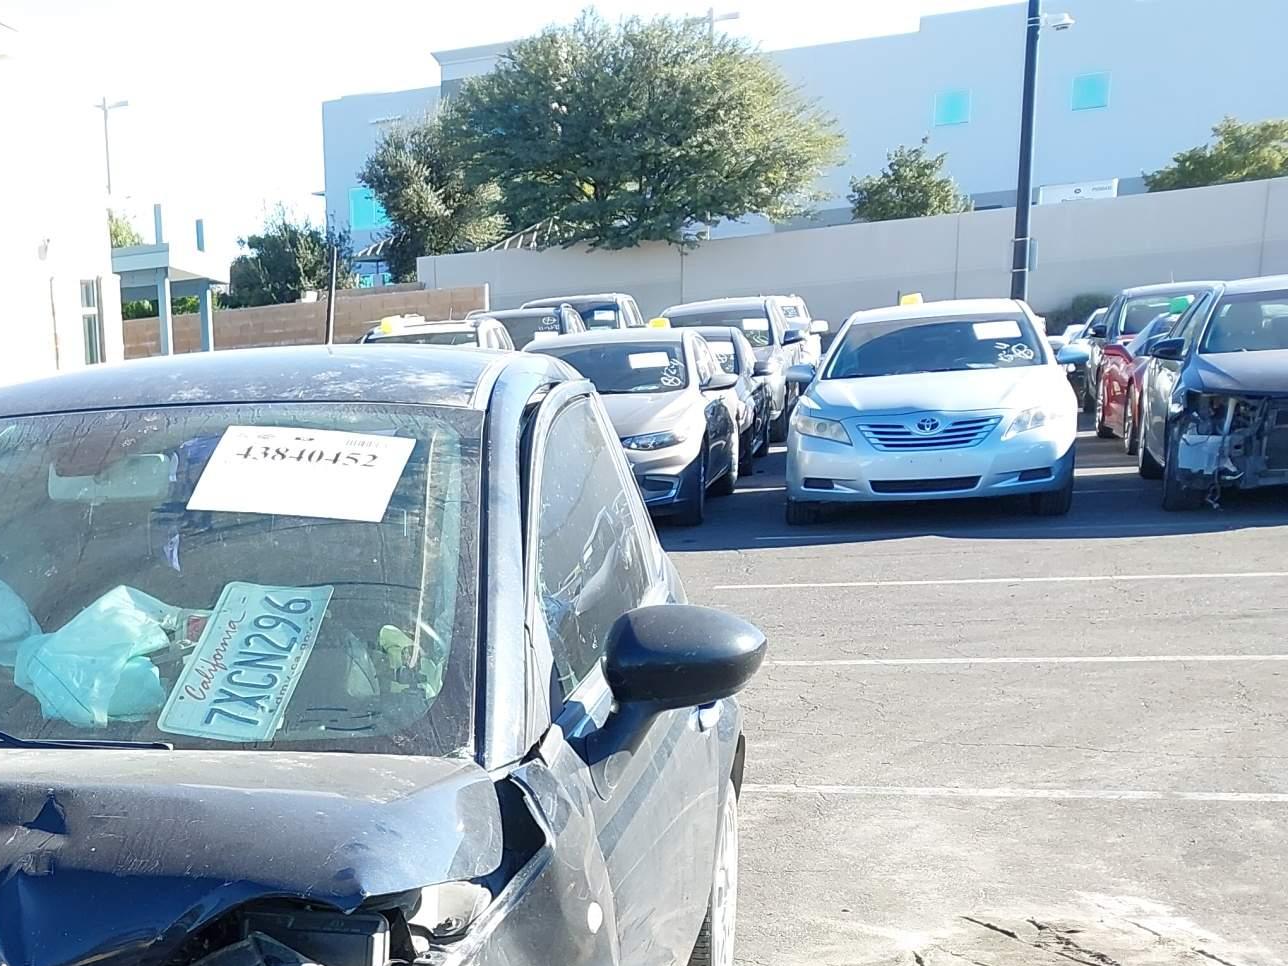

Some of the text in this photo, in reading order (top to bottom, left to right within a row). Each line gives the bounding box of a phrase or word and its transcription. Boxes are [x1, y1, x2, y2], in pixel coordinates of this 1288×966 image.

[235, 445, 378, 468] 43840452
[184, 610, 246, 701] California
[204, 595, 312, 726] 7XCN296
